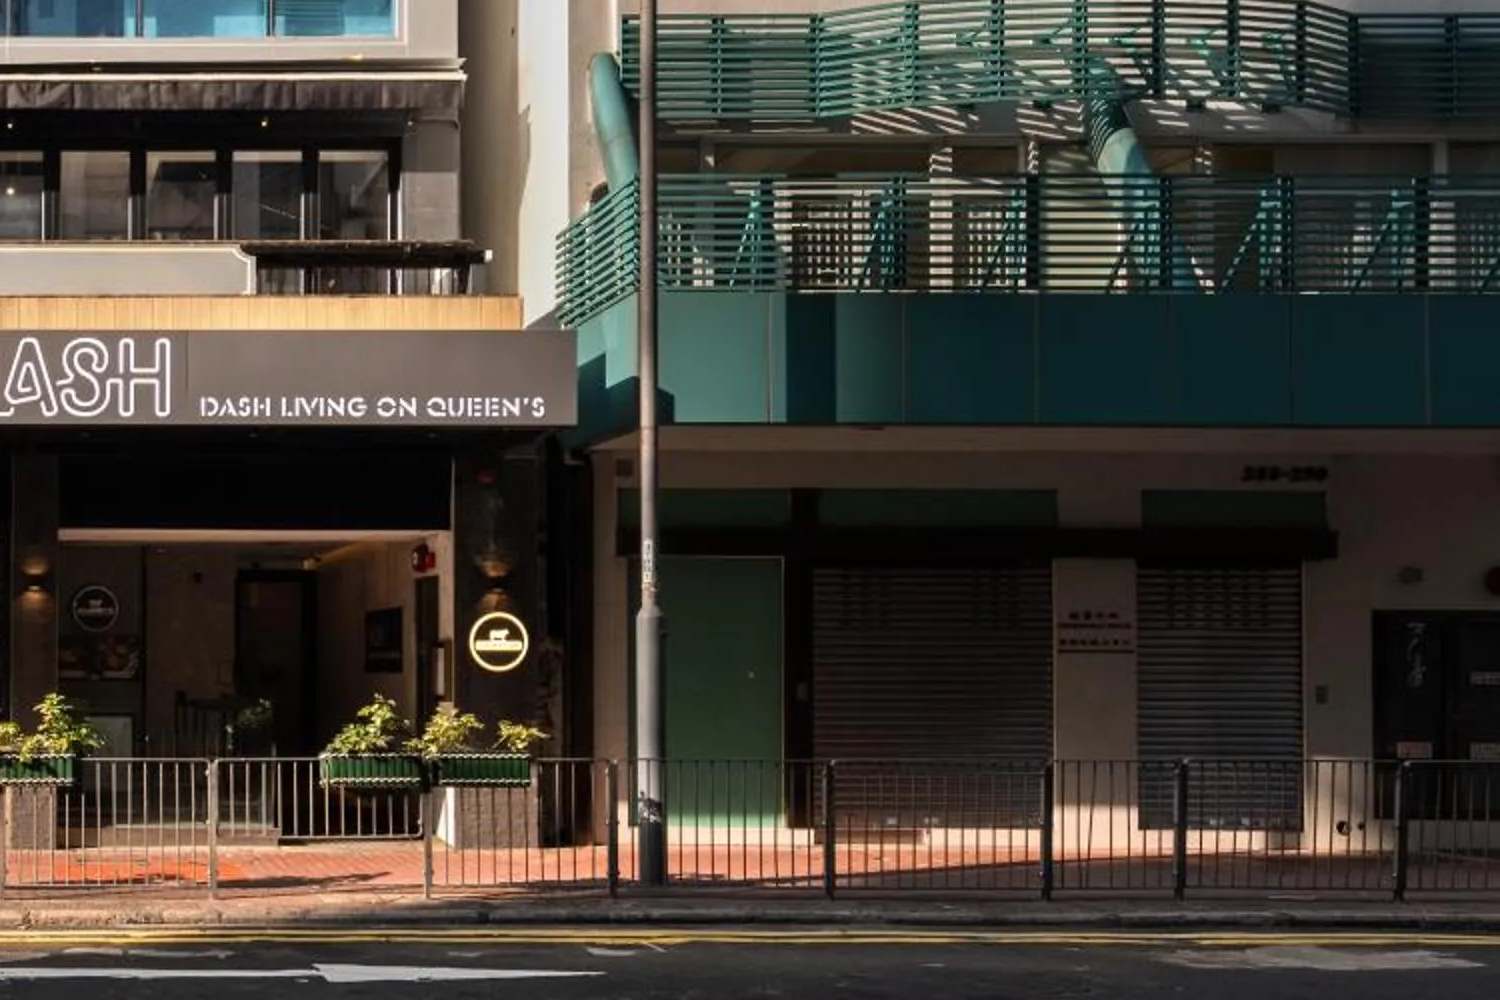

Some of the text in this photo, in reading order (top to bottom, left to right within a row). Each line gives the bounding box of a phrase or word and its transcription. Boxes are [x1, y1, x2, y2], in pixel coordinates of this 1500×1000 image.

[199, 396, 546, 418] DASH LIVING ON QUEEN'S
